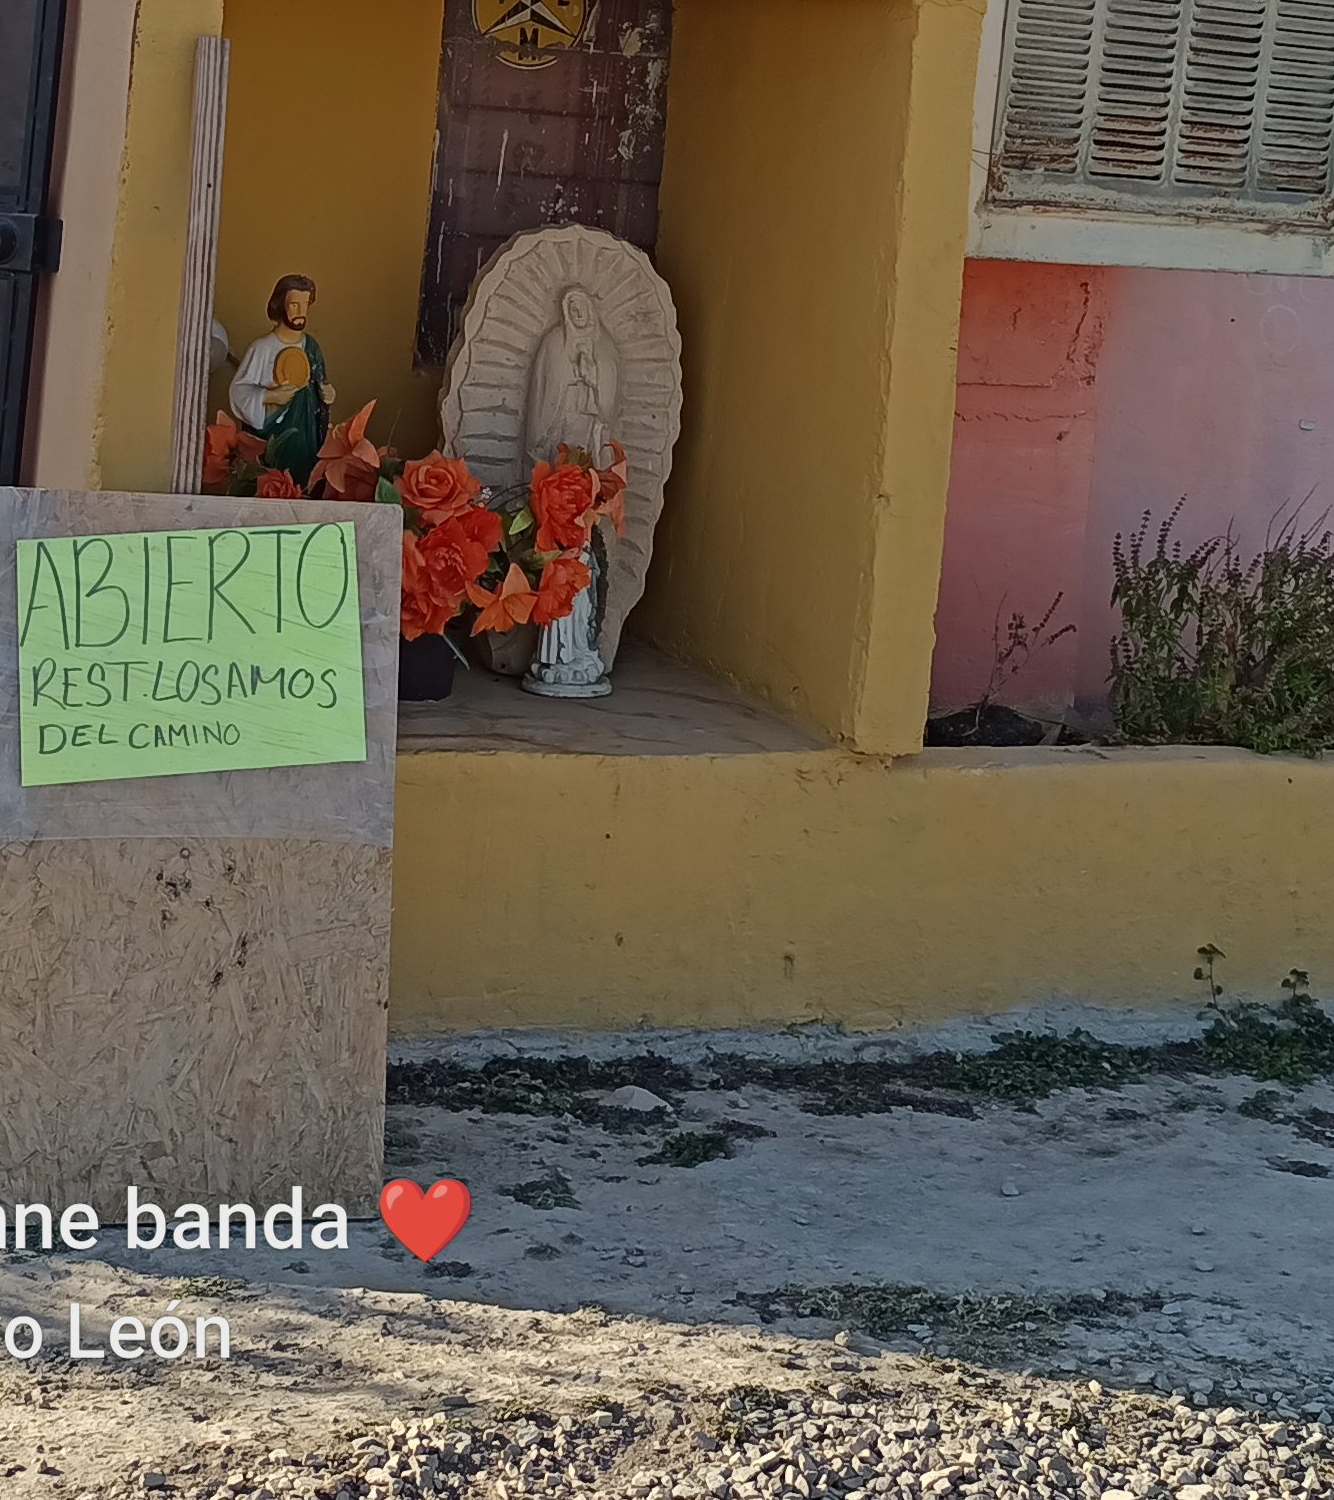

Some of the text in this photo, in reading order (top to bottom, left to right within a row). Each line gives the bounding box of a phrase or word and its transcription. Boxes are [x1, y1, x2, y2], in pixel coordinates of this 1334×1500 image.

[20, 522, 349, 650] ABIERTO
[38, 721, 241, 755] DEL CAMINO
